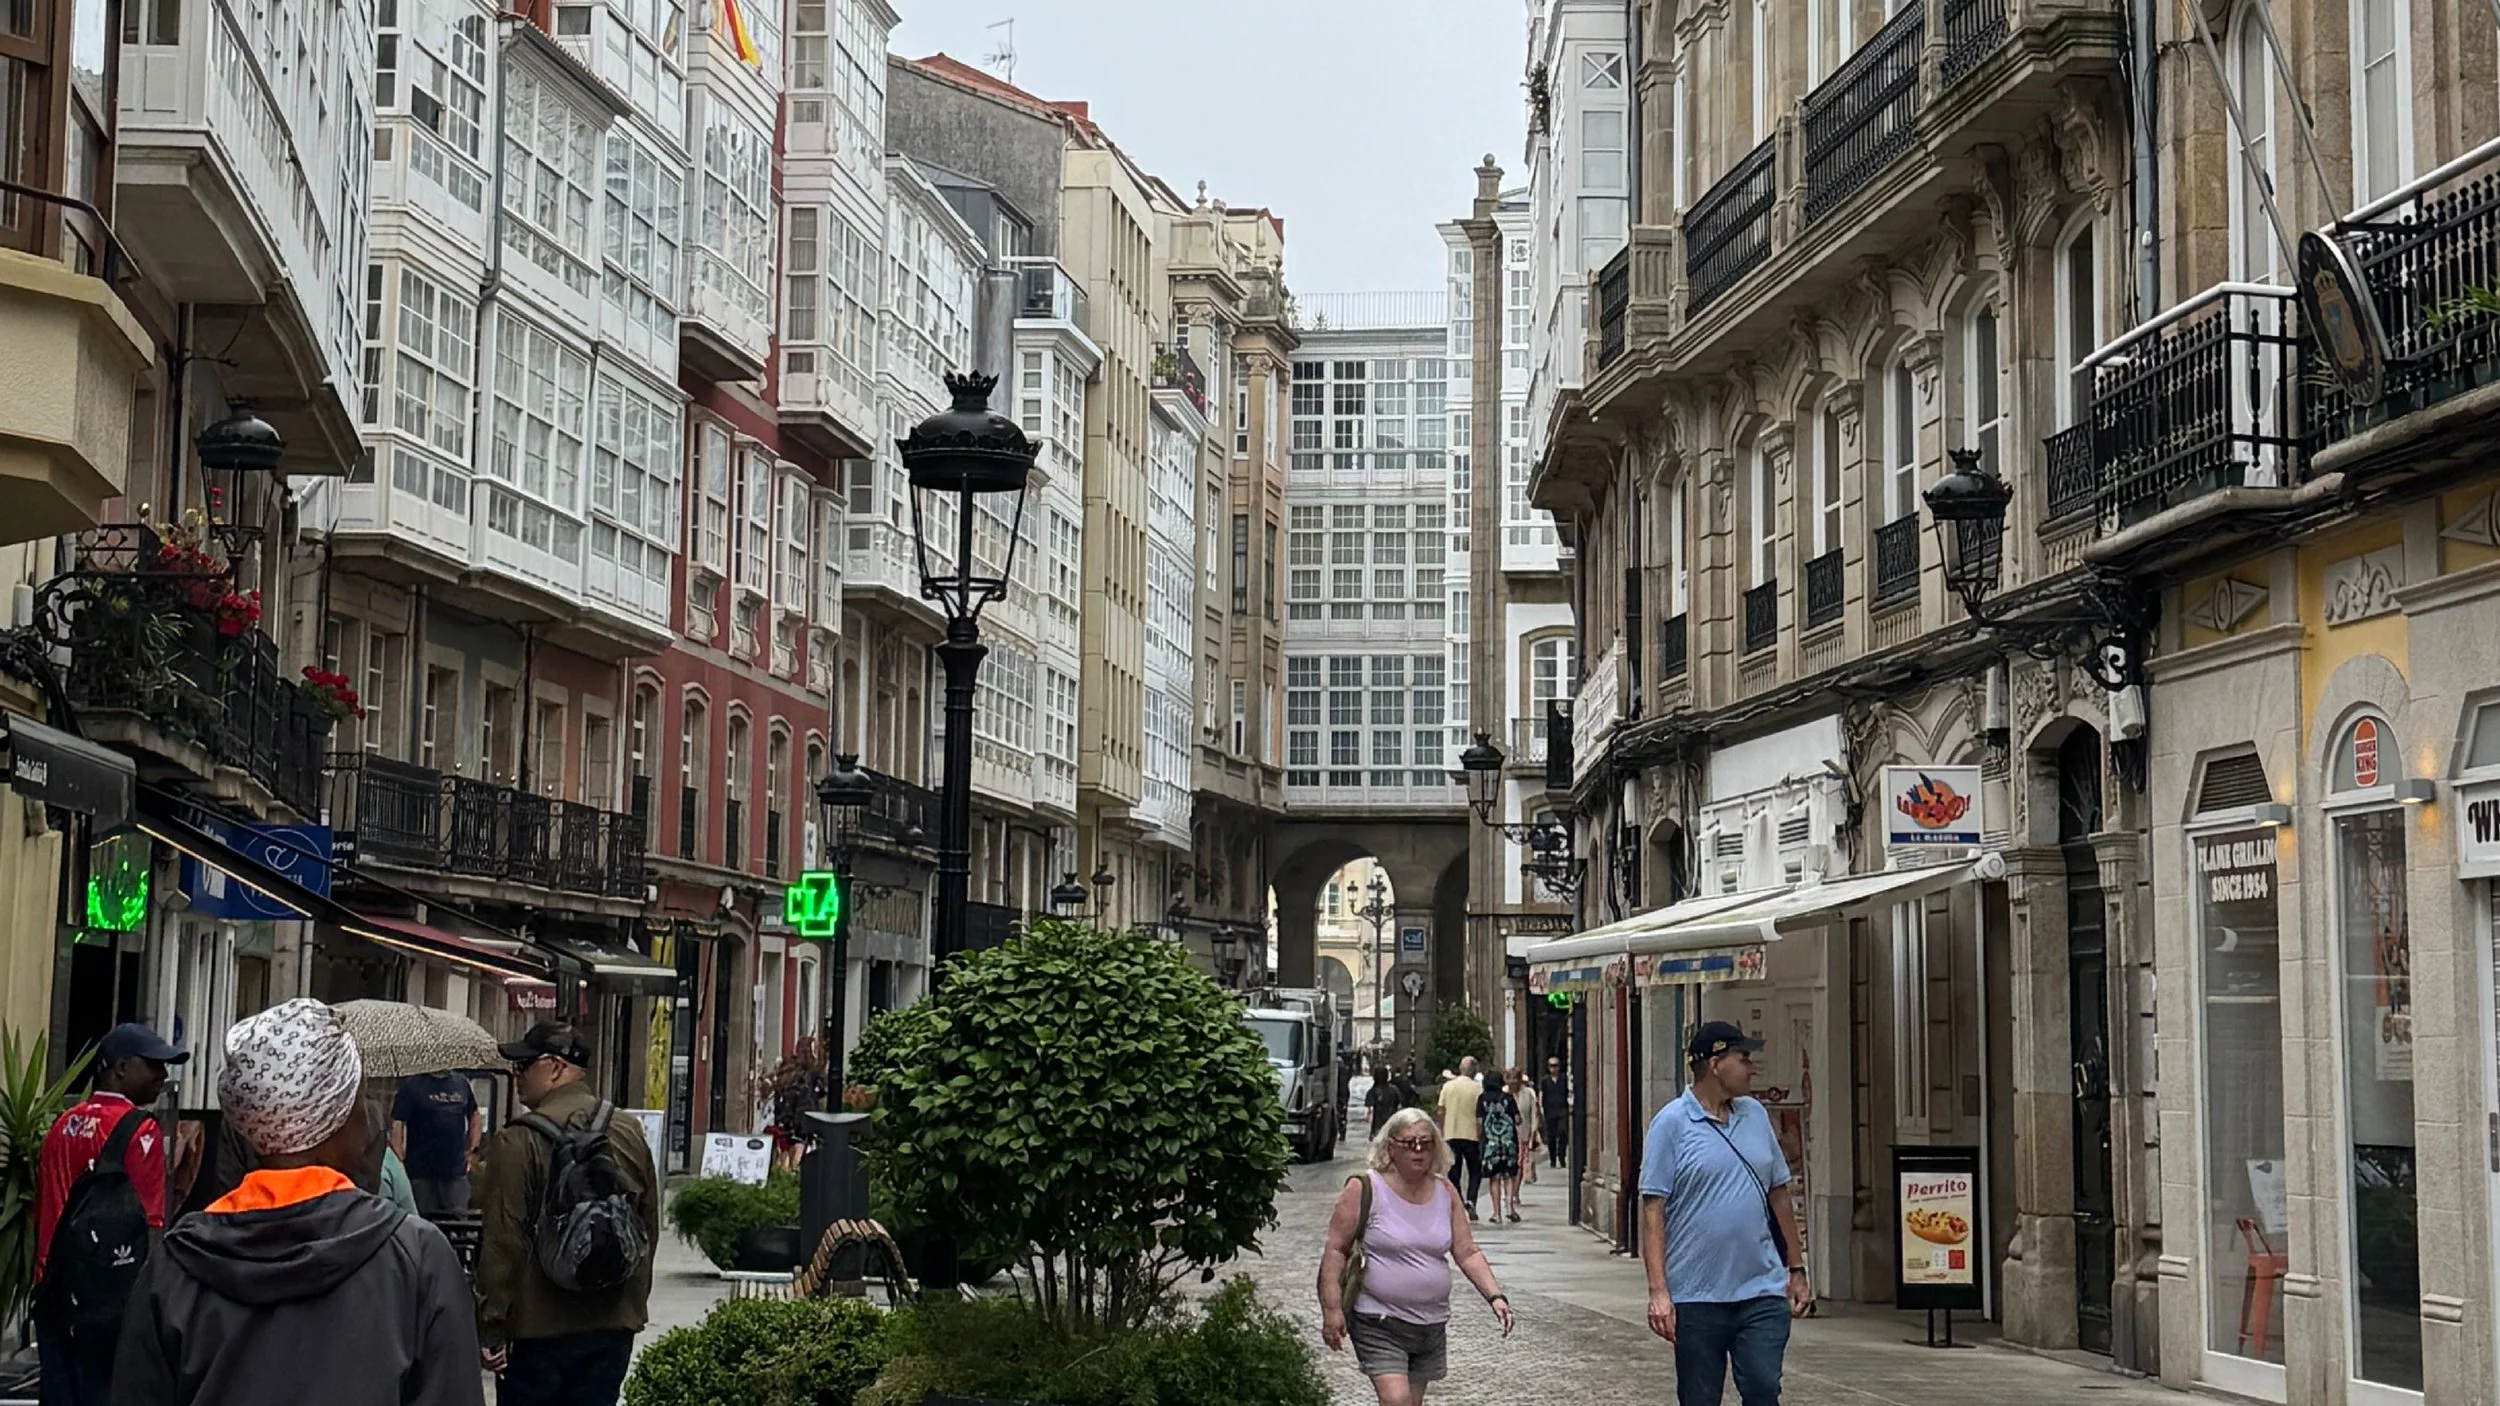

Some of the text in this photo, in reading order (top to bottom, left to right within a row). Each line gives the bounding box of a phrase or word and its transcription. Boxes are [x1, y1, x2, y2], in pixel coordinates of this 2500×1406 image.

[2197, 843, 2232, 873] FLAME
[2211, 871, 2269, 902] SINCE 1954
